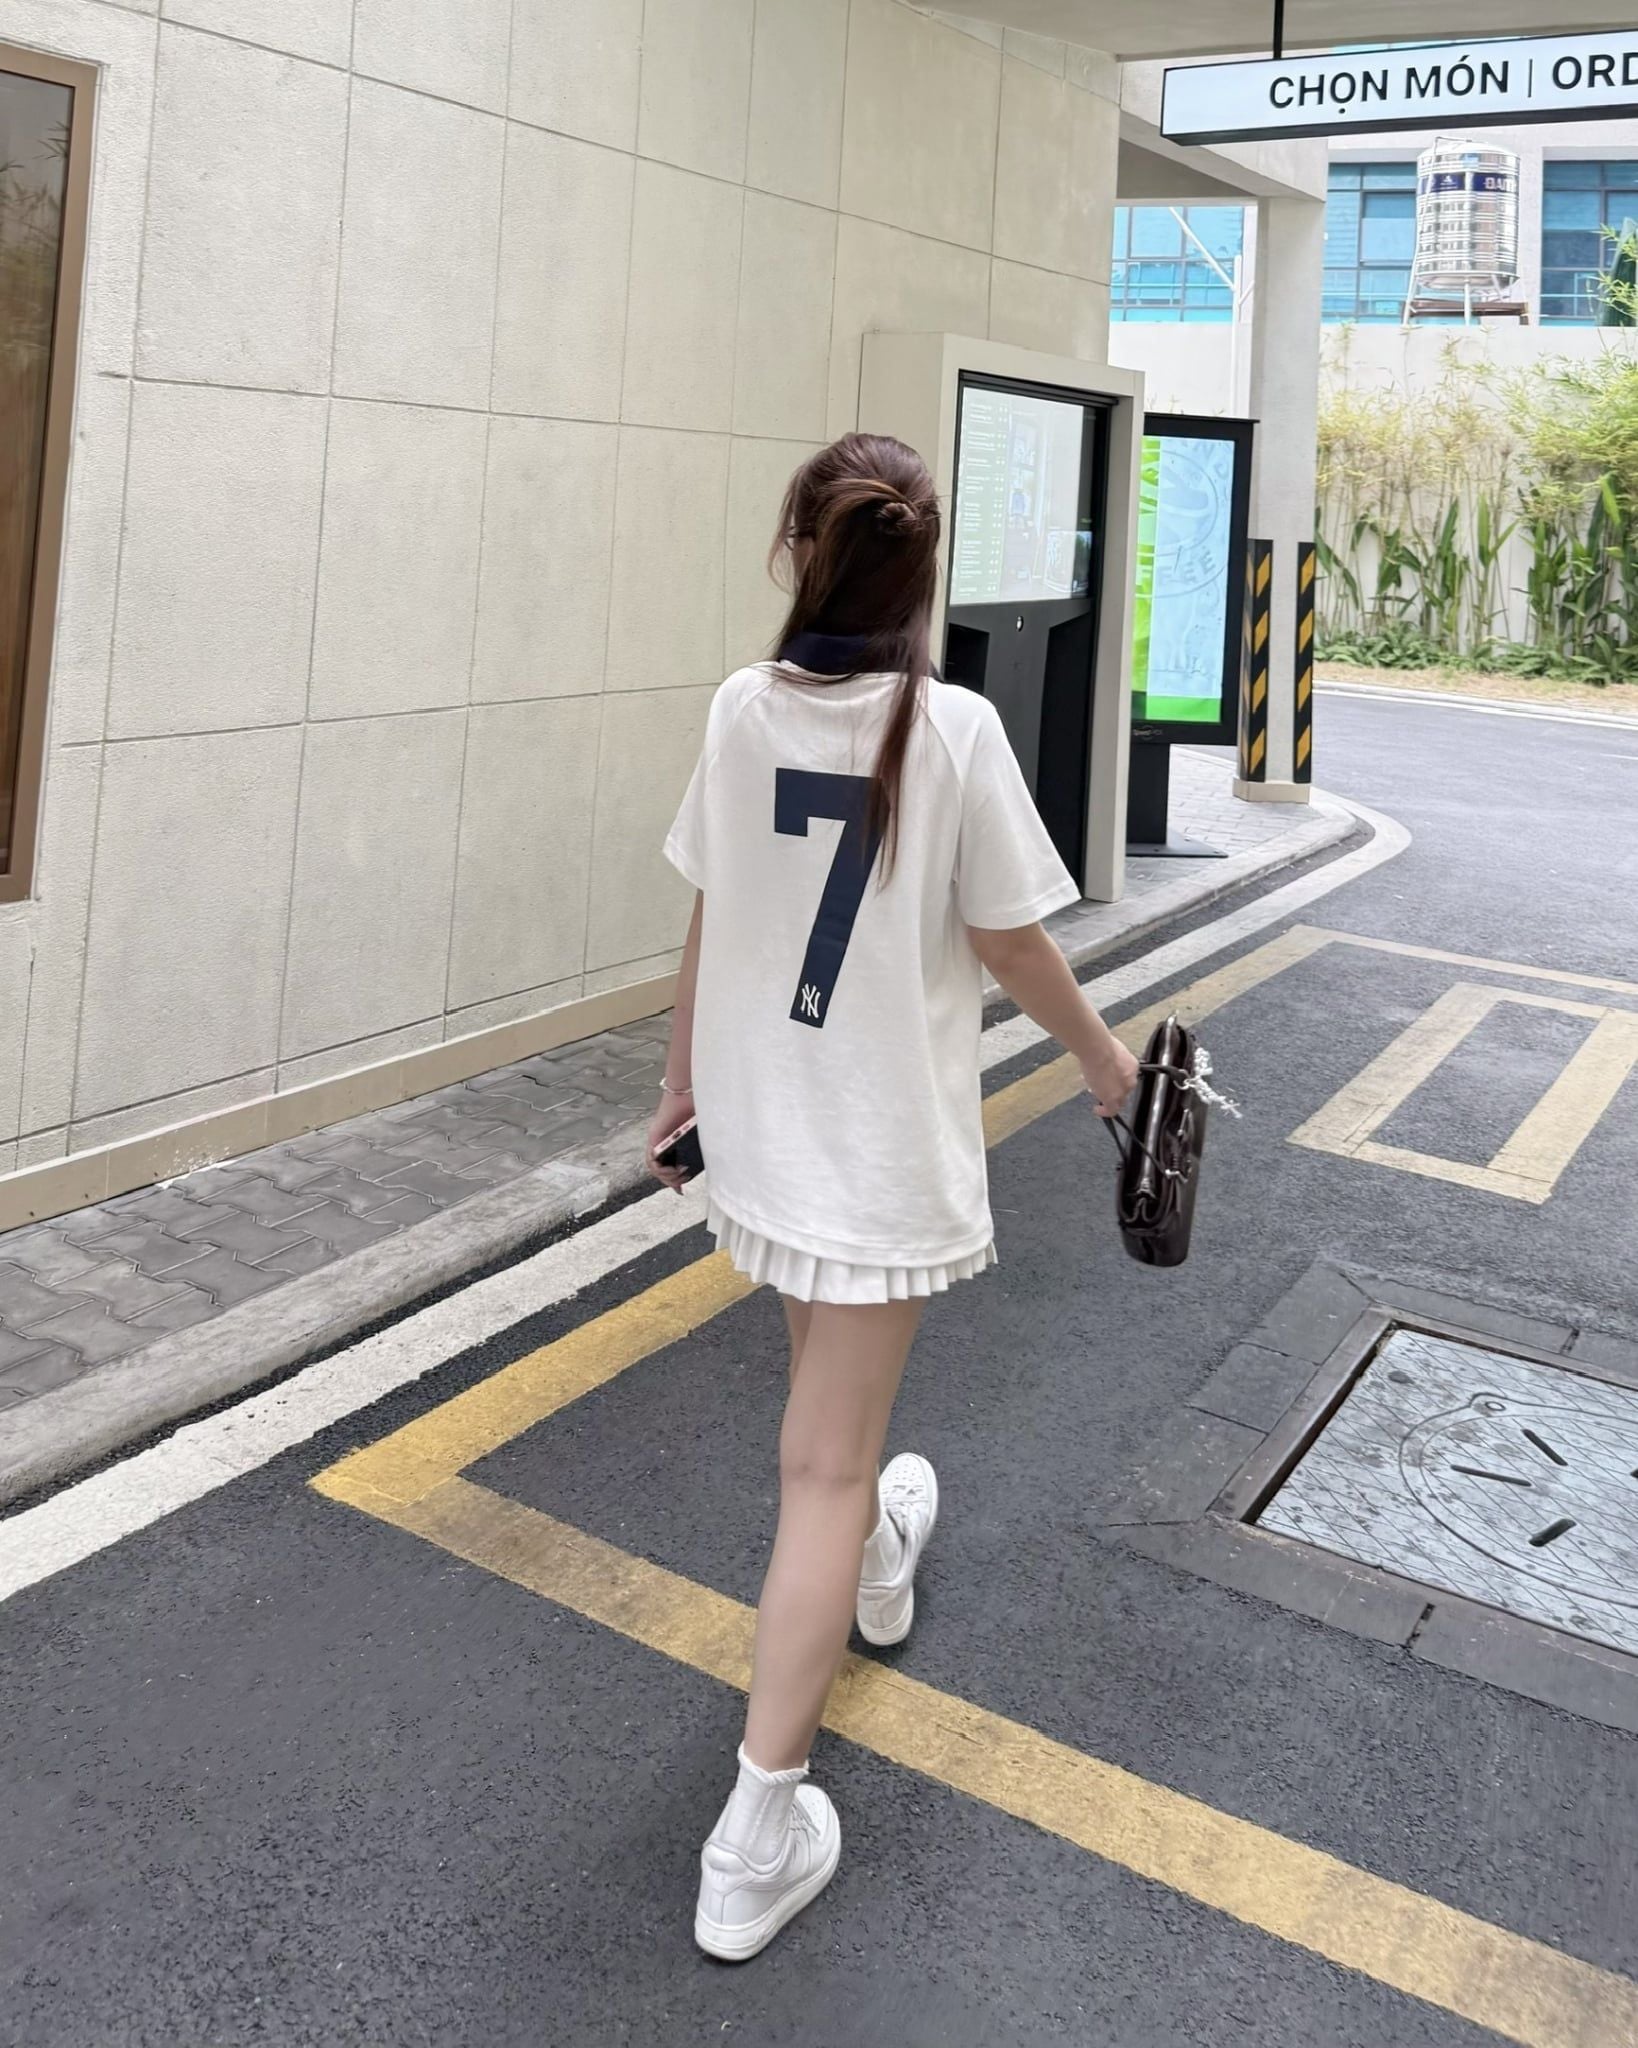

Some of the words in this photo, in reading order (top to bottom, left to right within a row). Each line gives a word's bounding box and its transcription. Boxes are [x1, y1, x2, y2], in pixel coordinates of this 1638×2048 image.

[1269, 69, 1388, 114] CHỌN
[1405, 54, 1509, 99] MÓN
[1552, 52, 1638, 90] ORD
[774, 767, 891, 1029] 7
[801, 983, 821, 1018] NY
